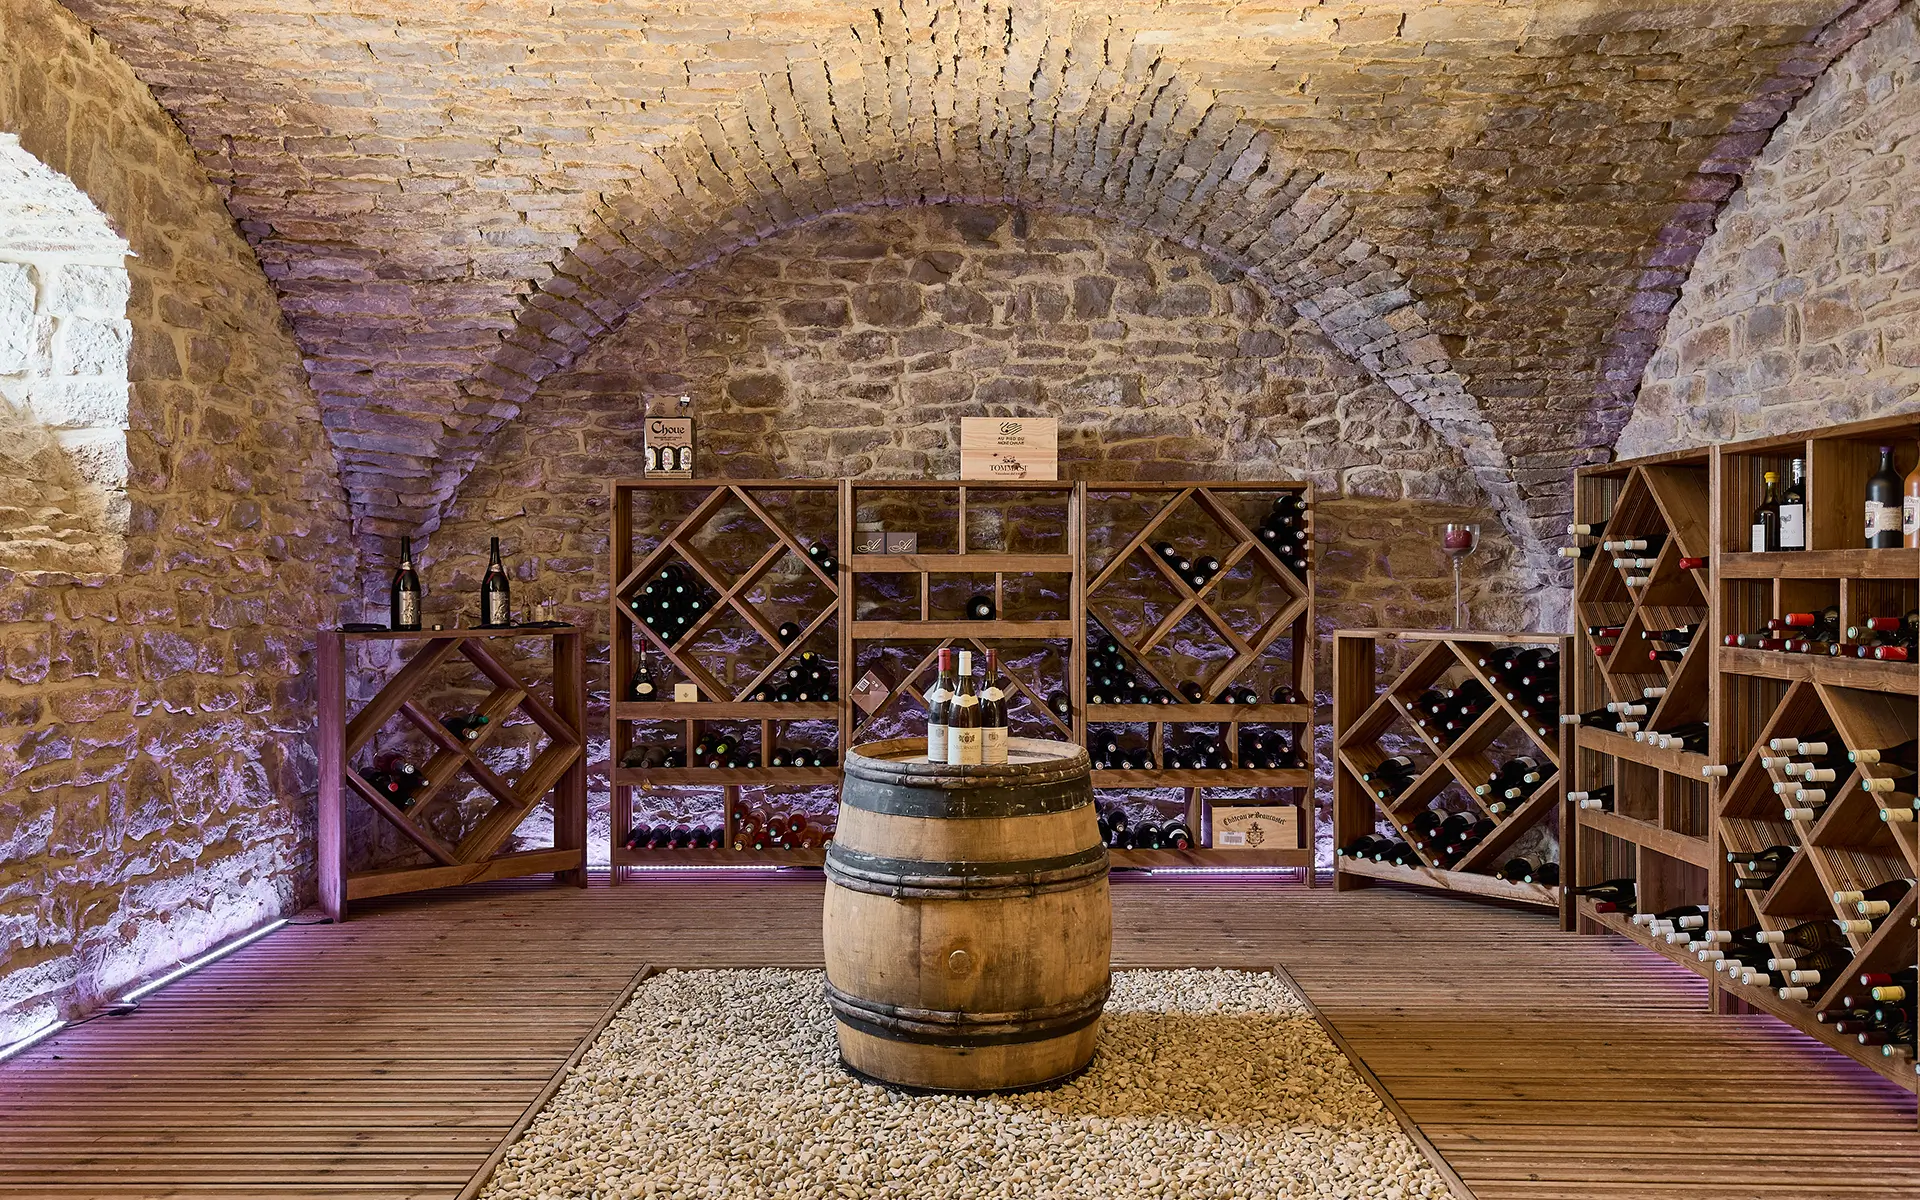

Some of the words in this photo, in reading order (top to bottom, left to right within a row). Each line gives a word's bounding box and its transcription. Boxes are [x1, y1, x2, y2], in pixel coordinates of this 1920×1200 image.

[651, 420, 685, 436] Choue
[1223, 814, 1247, 826] Château
[1254, 811, 1287, 826] Beaucastel
